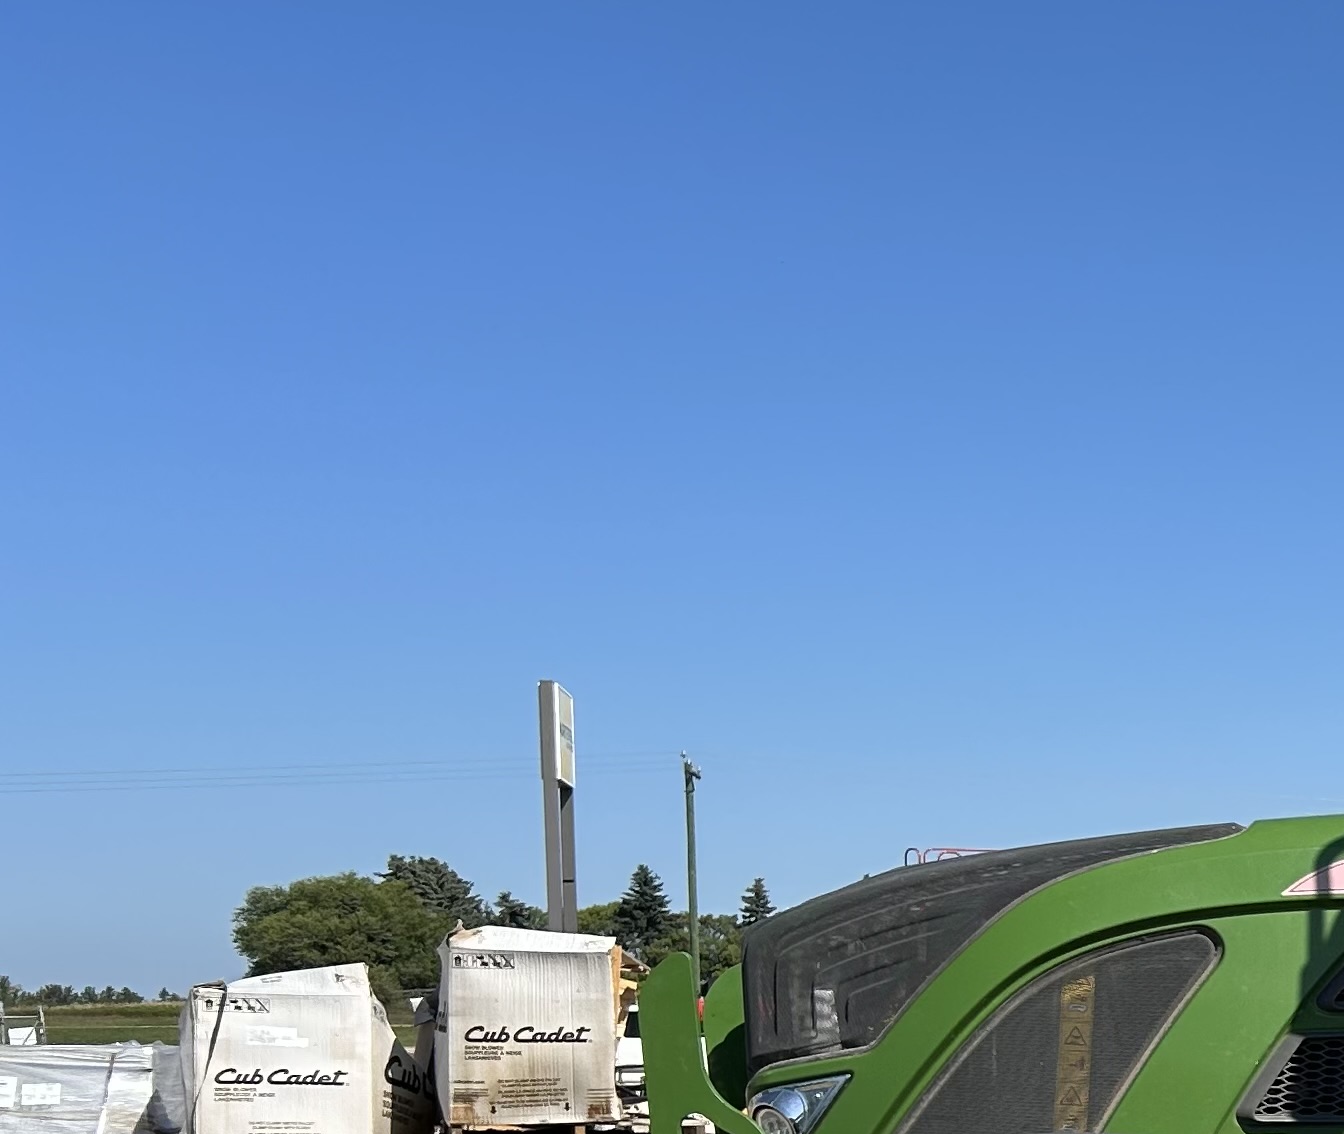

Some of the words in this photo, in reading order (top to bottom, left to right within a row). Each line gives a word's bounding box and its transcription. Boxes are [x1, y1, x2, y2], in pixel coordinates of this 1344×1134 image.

[465, 1026, 510, 1043] Cub
[513, 1026, 592, 1043] Cadet
[214, 1068, 264, 1085] Cub
[267, 1068, 349, 1086] Cadet
[384, 1055, 421, 1095] Cub
